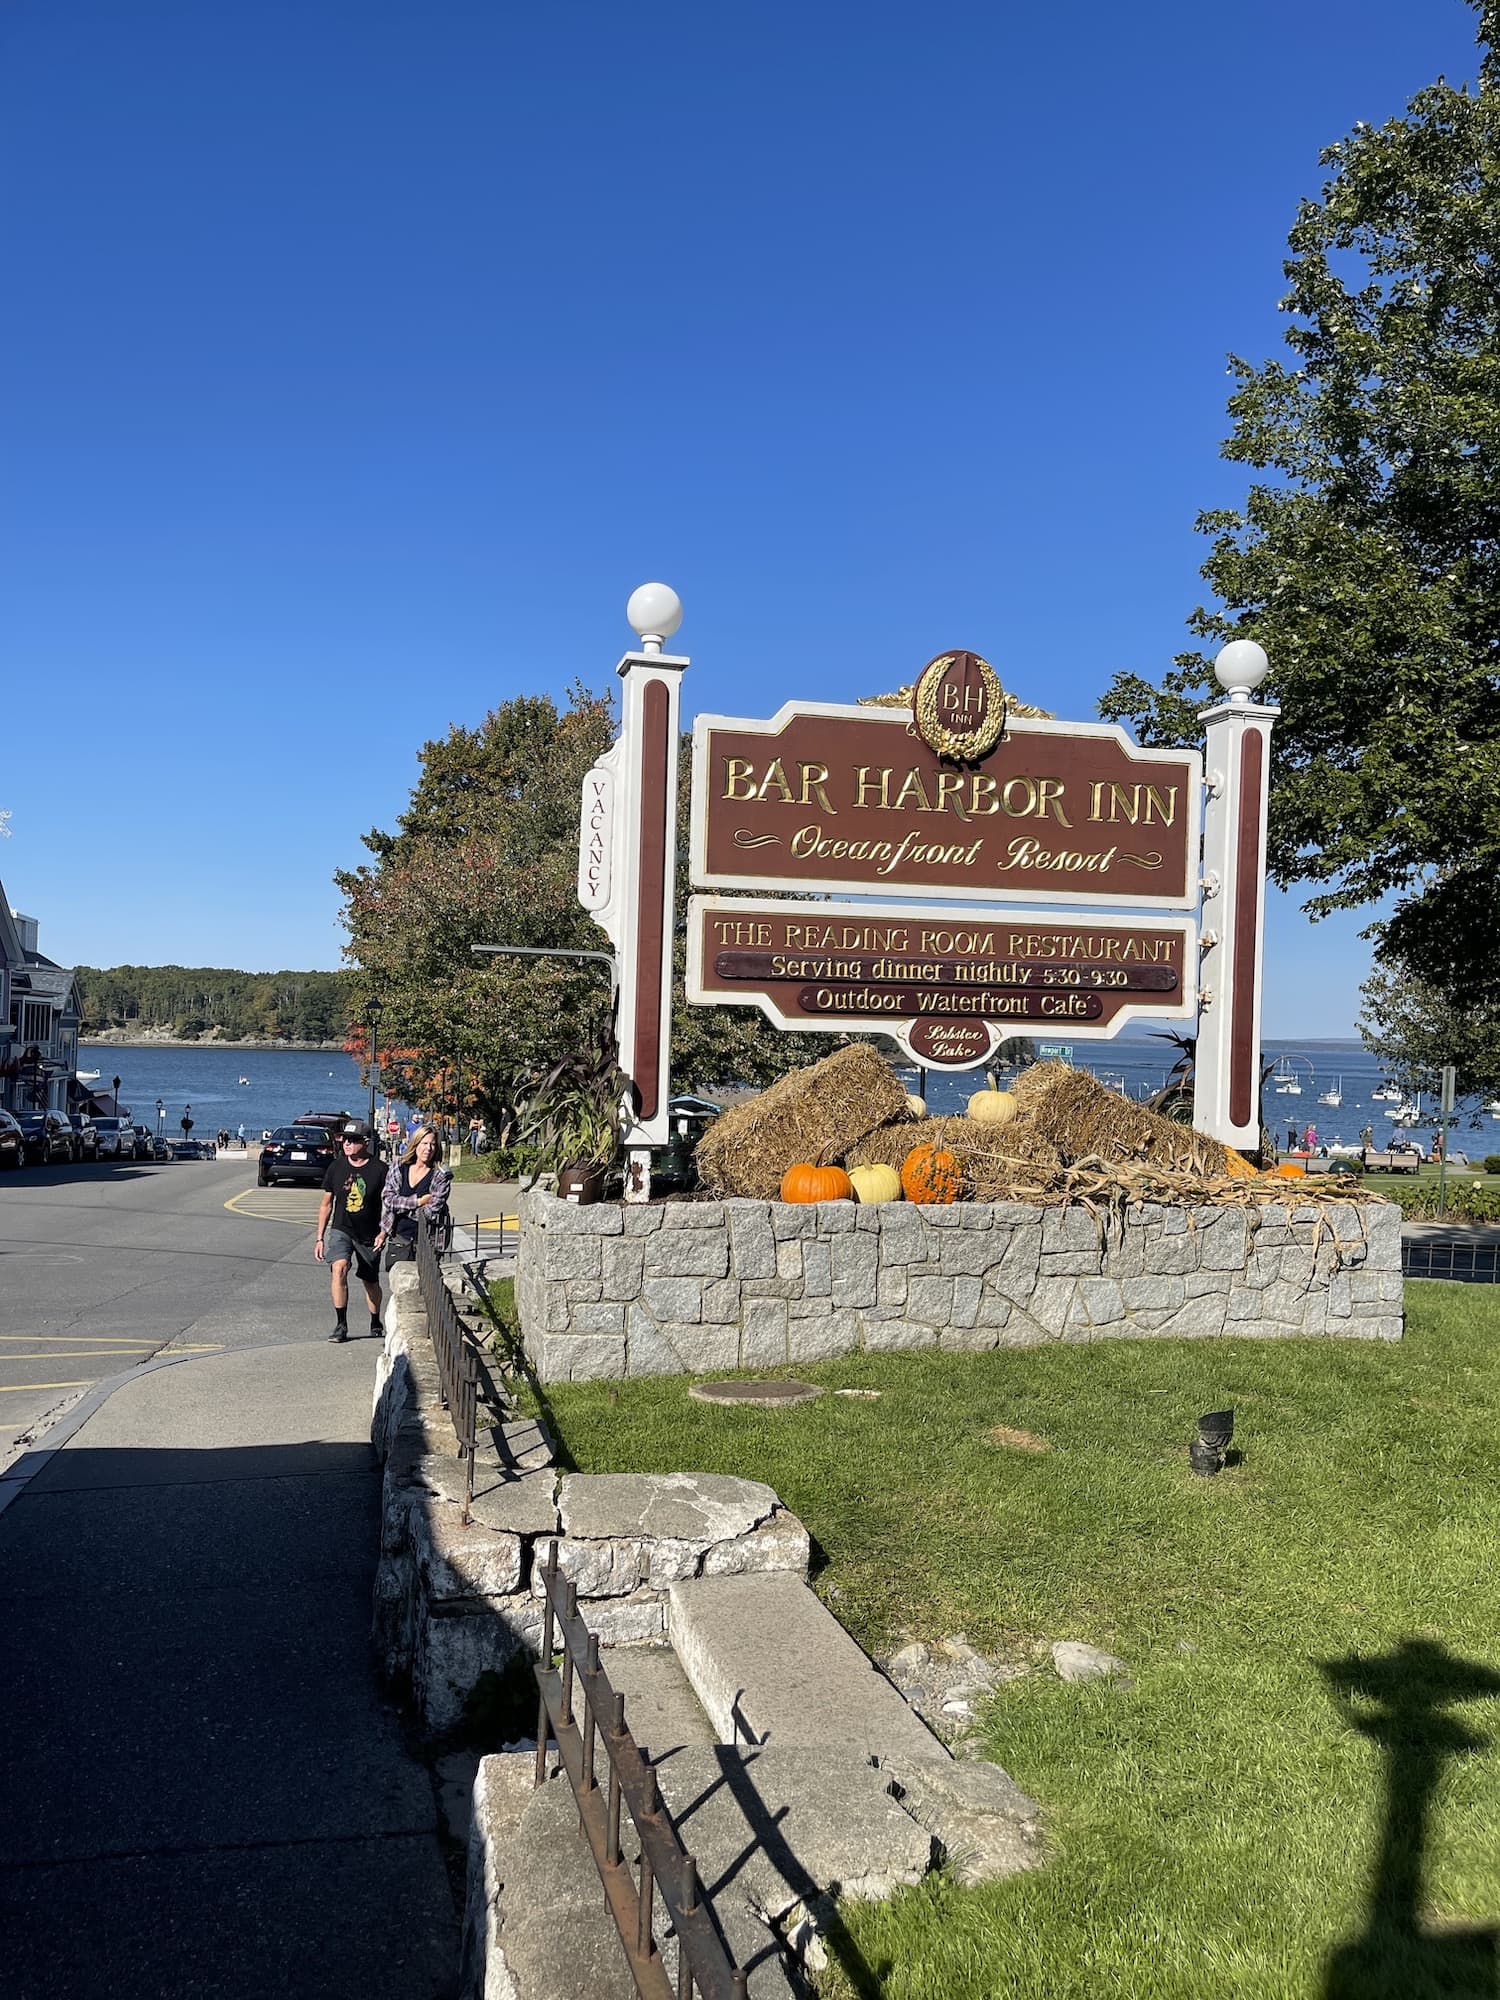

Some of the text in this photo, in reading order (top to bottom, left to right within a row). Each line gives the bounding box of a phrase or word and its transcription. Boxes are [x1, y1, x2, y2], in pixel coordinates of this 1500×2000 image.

[943, 683, 983, 713] BH
[950, 713, 973, 725] INN
[721, 755, 1179, 829] BAR HARBOR INN
[587, 782, 606, 897] VACANCY
[790, 823, 1118, 876] Oceanfront Resort
[713, 921, 1176, 962] THE READING ROOM RESTAURANT
[770, 954, 862, 980] Serving
[871, 957, 944, 981] dinner
[954, 961, 1032, 985] nightly
[816, 988, 1093, 1016] Outdoor Waterfront Café
[924, 1025, 983, 1041] Lobster
[928, 1041, 977, 1057] Bake
